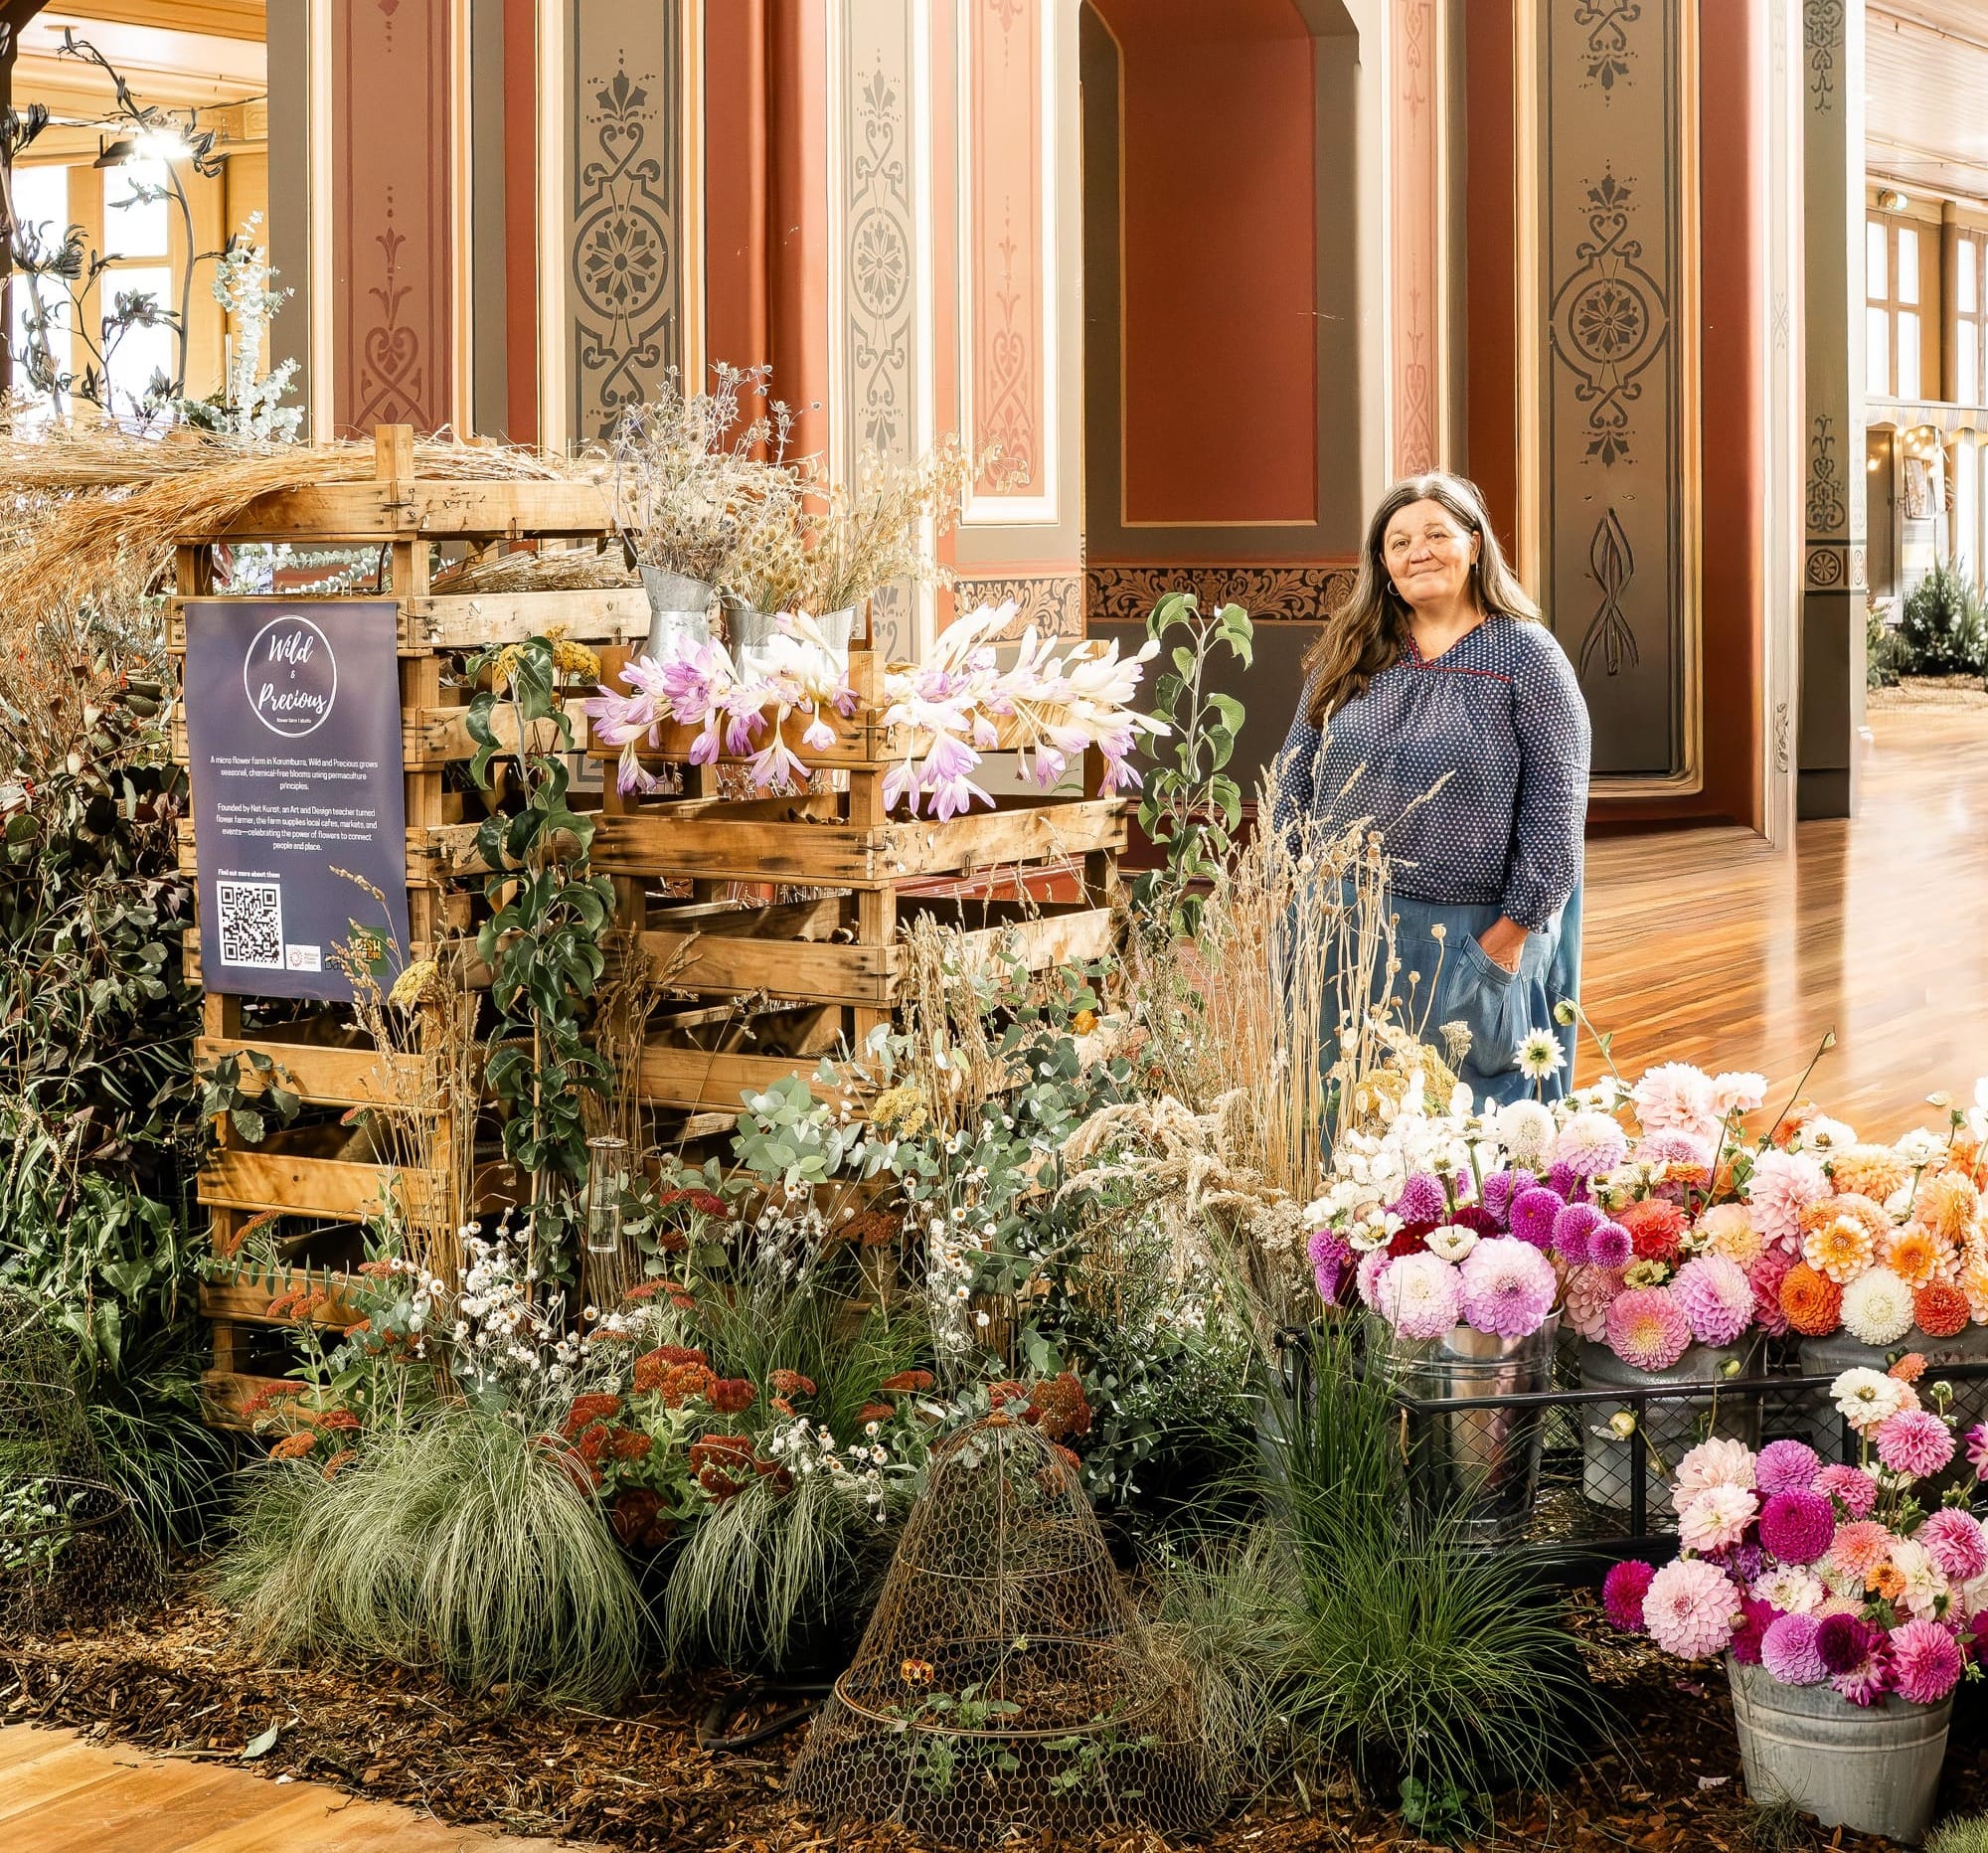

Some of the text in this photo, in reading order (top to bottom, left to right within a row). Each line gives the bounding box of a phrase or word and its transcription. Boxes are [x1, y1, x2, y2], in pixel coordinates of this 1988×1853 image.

[268, 630, 314, 665] Wild
[290, 670, 295, 679] &
[258, 682, 327, 714] Precious
[233, 756, 250, 764] flower
[308, 758, 321, 766] Wild
[333, 758, 358, 767] Precious
[221, 768, 367, 780] seasonal, chemical-free blooms using permaculture
[279, 781, 309, 790] principles.
[217, 802, 242, 812] Founded
[243, 803, 249, 813] by
[311, 806, 332, 816] Design
[356, 808, 376, 817] turned
[216, 814, 234, 823] flower
[234, 815, 255, 824] farmer,
[256, 815, 266, 824] the
[282, 817, 305, 827] supplies
[306, 817, 320, 826] local
[340, 820, 366, 829] markets,
[366, 820, 378, 829] and
[318, 830, 340, 839] flowers
[341, 831, 347, 840] to
[272, 841, 292, 851] people
[304, 842, 322, 851] place.
[266, 870, 280, 879] them
